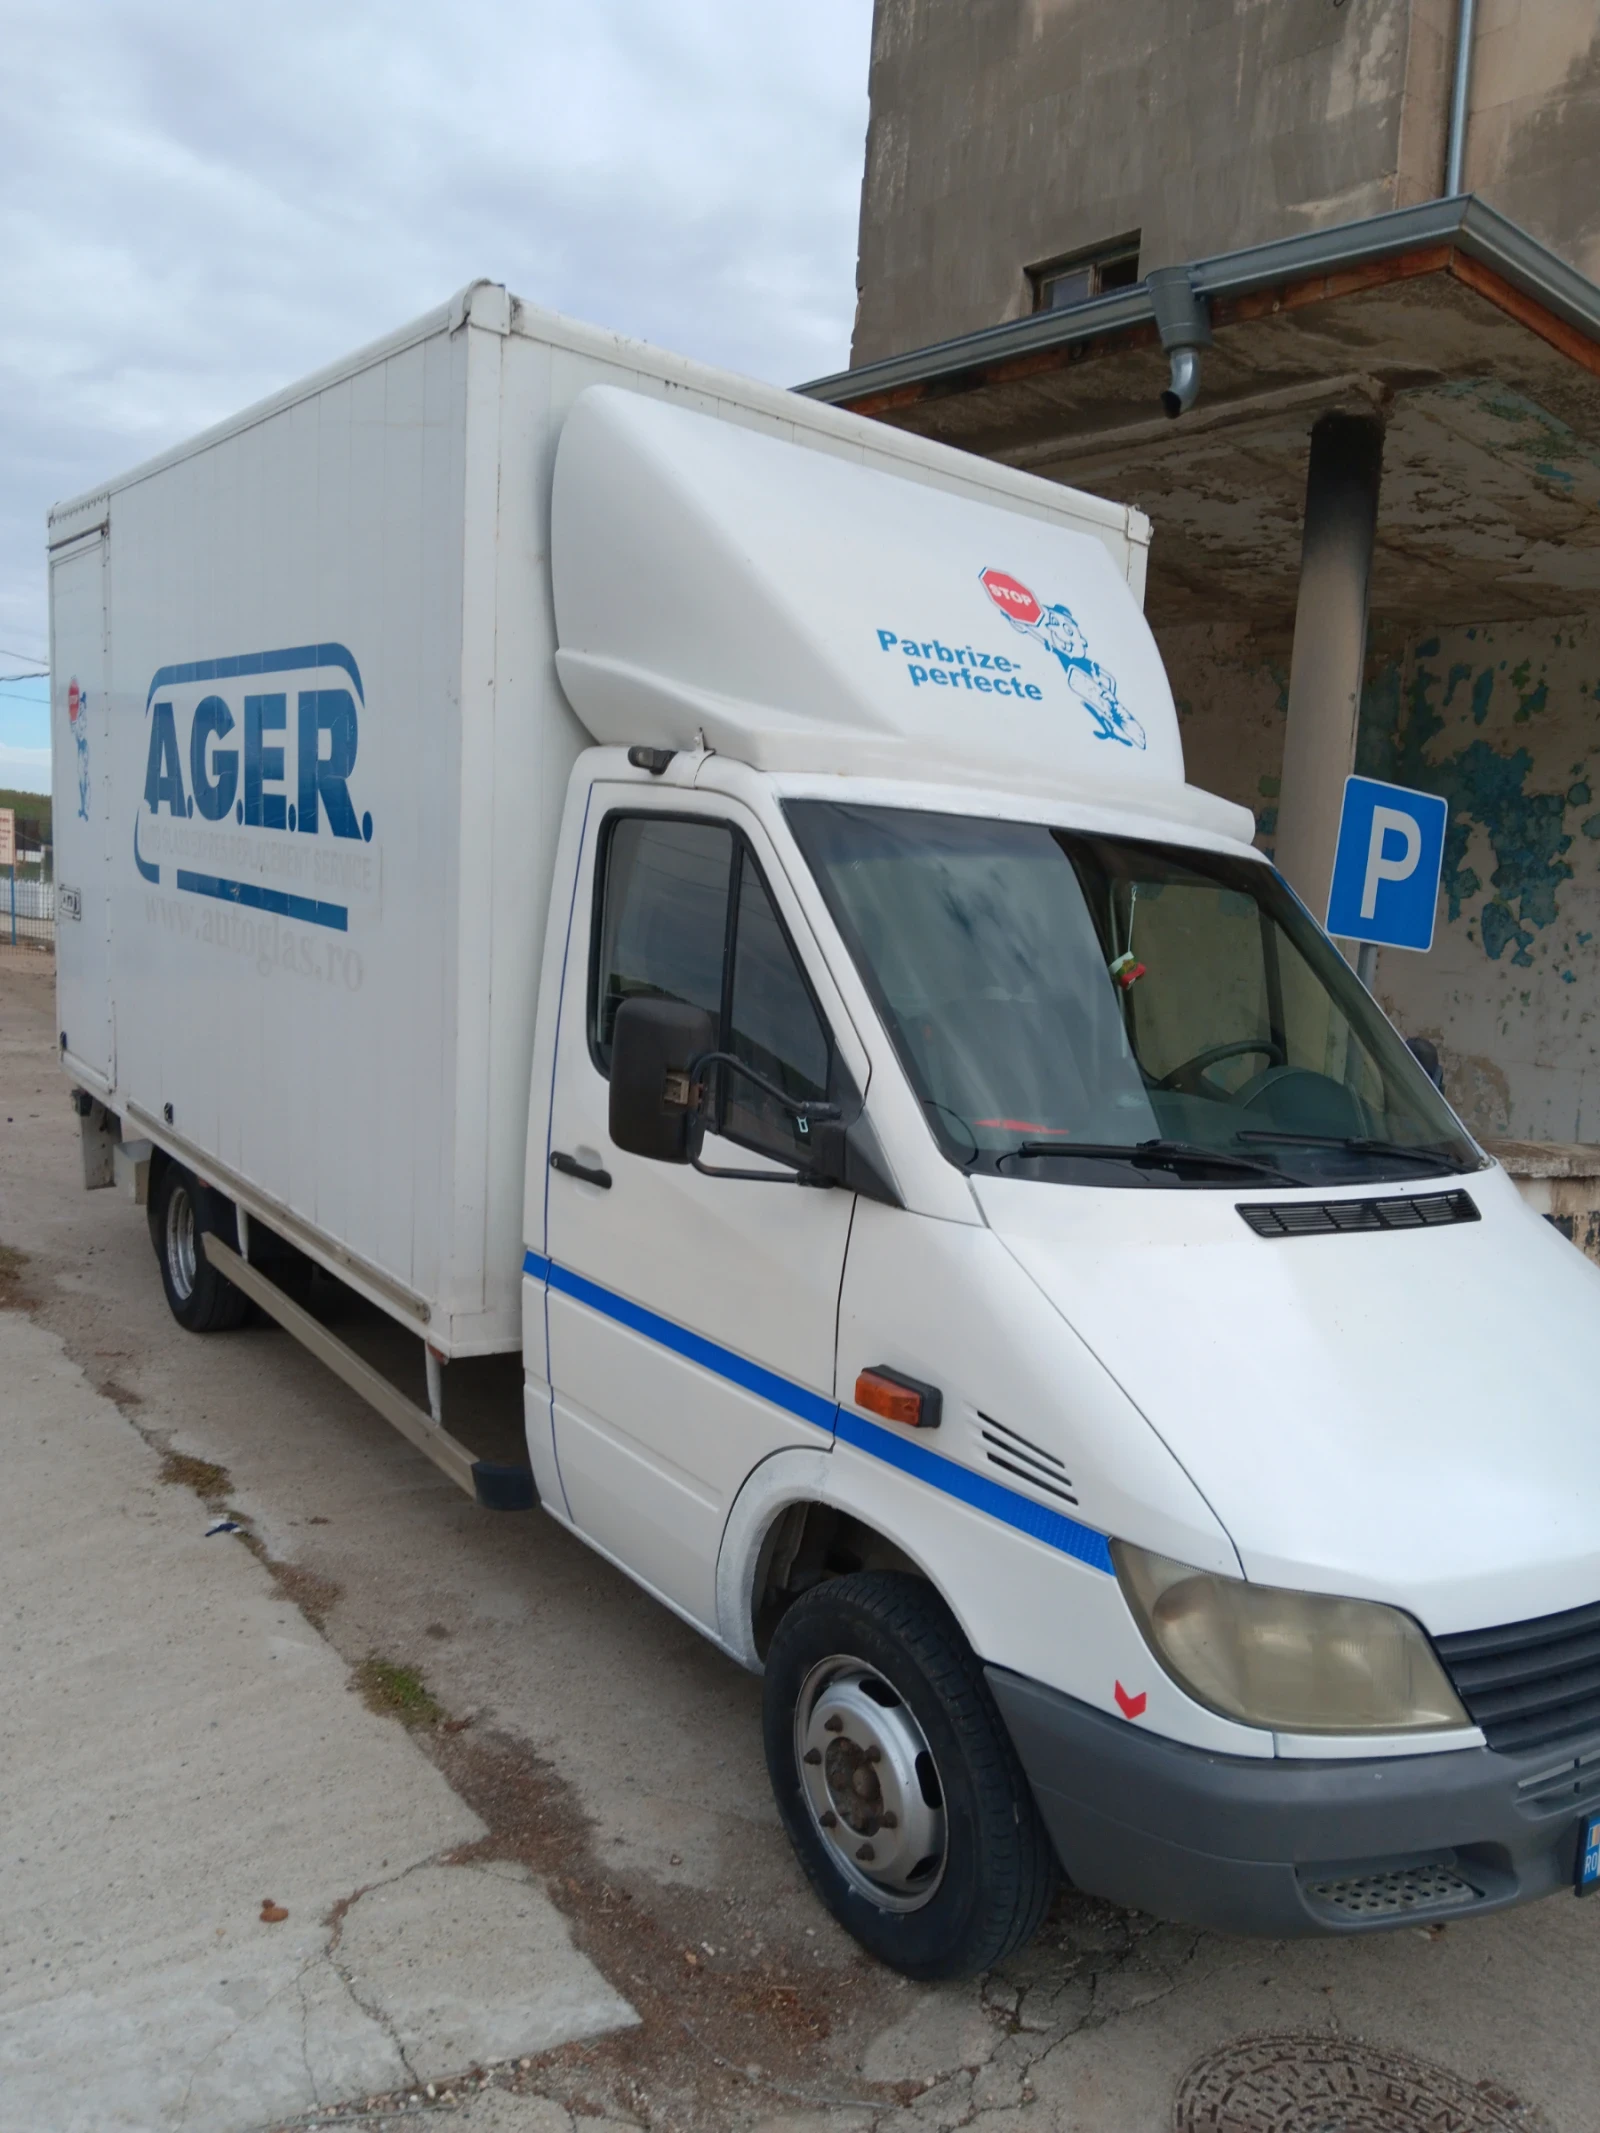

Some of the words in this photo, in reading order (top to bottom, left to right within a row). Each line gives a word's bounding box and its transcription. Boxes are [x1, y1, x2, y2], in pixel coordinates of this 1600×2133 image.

[988, 584, 1033, 607] STOP
[876, 629, 1021, 672] Parbrize-
[907, 663, 1043, 701] perfecte
[144, 688, 373, 843] A.G.E.R.
[313, 848, 373, 892] SERVICE
[1360, 805, 1422, 920] P
[144, 894, 365, 992] www.autoglas.ro
[1585, 1852, 1598, 1875] RO
